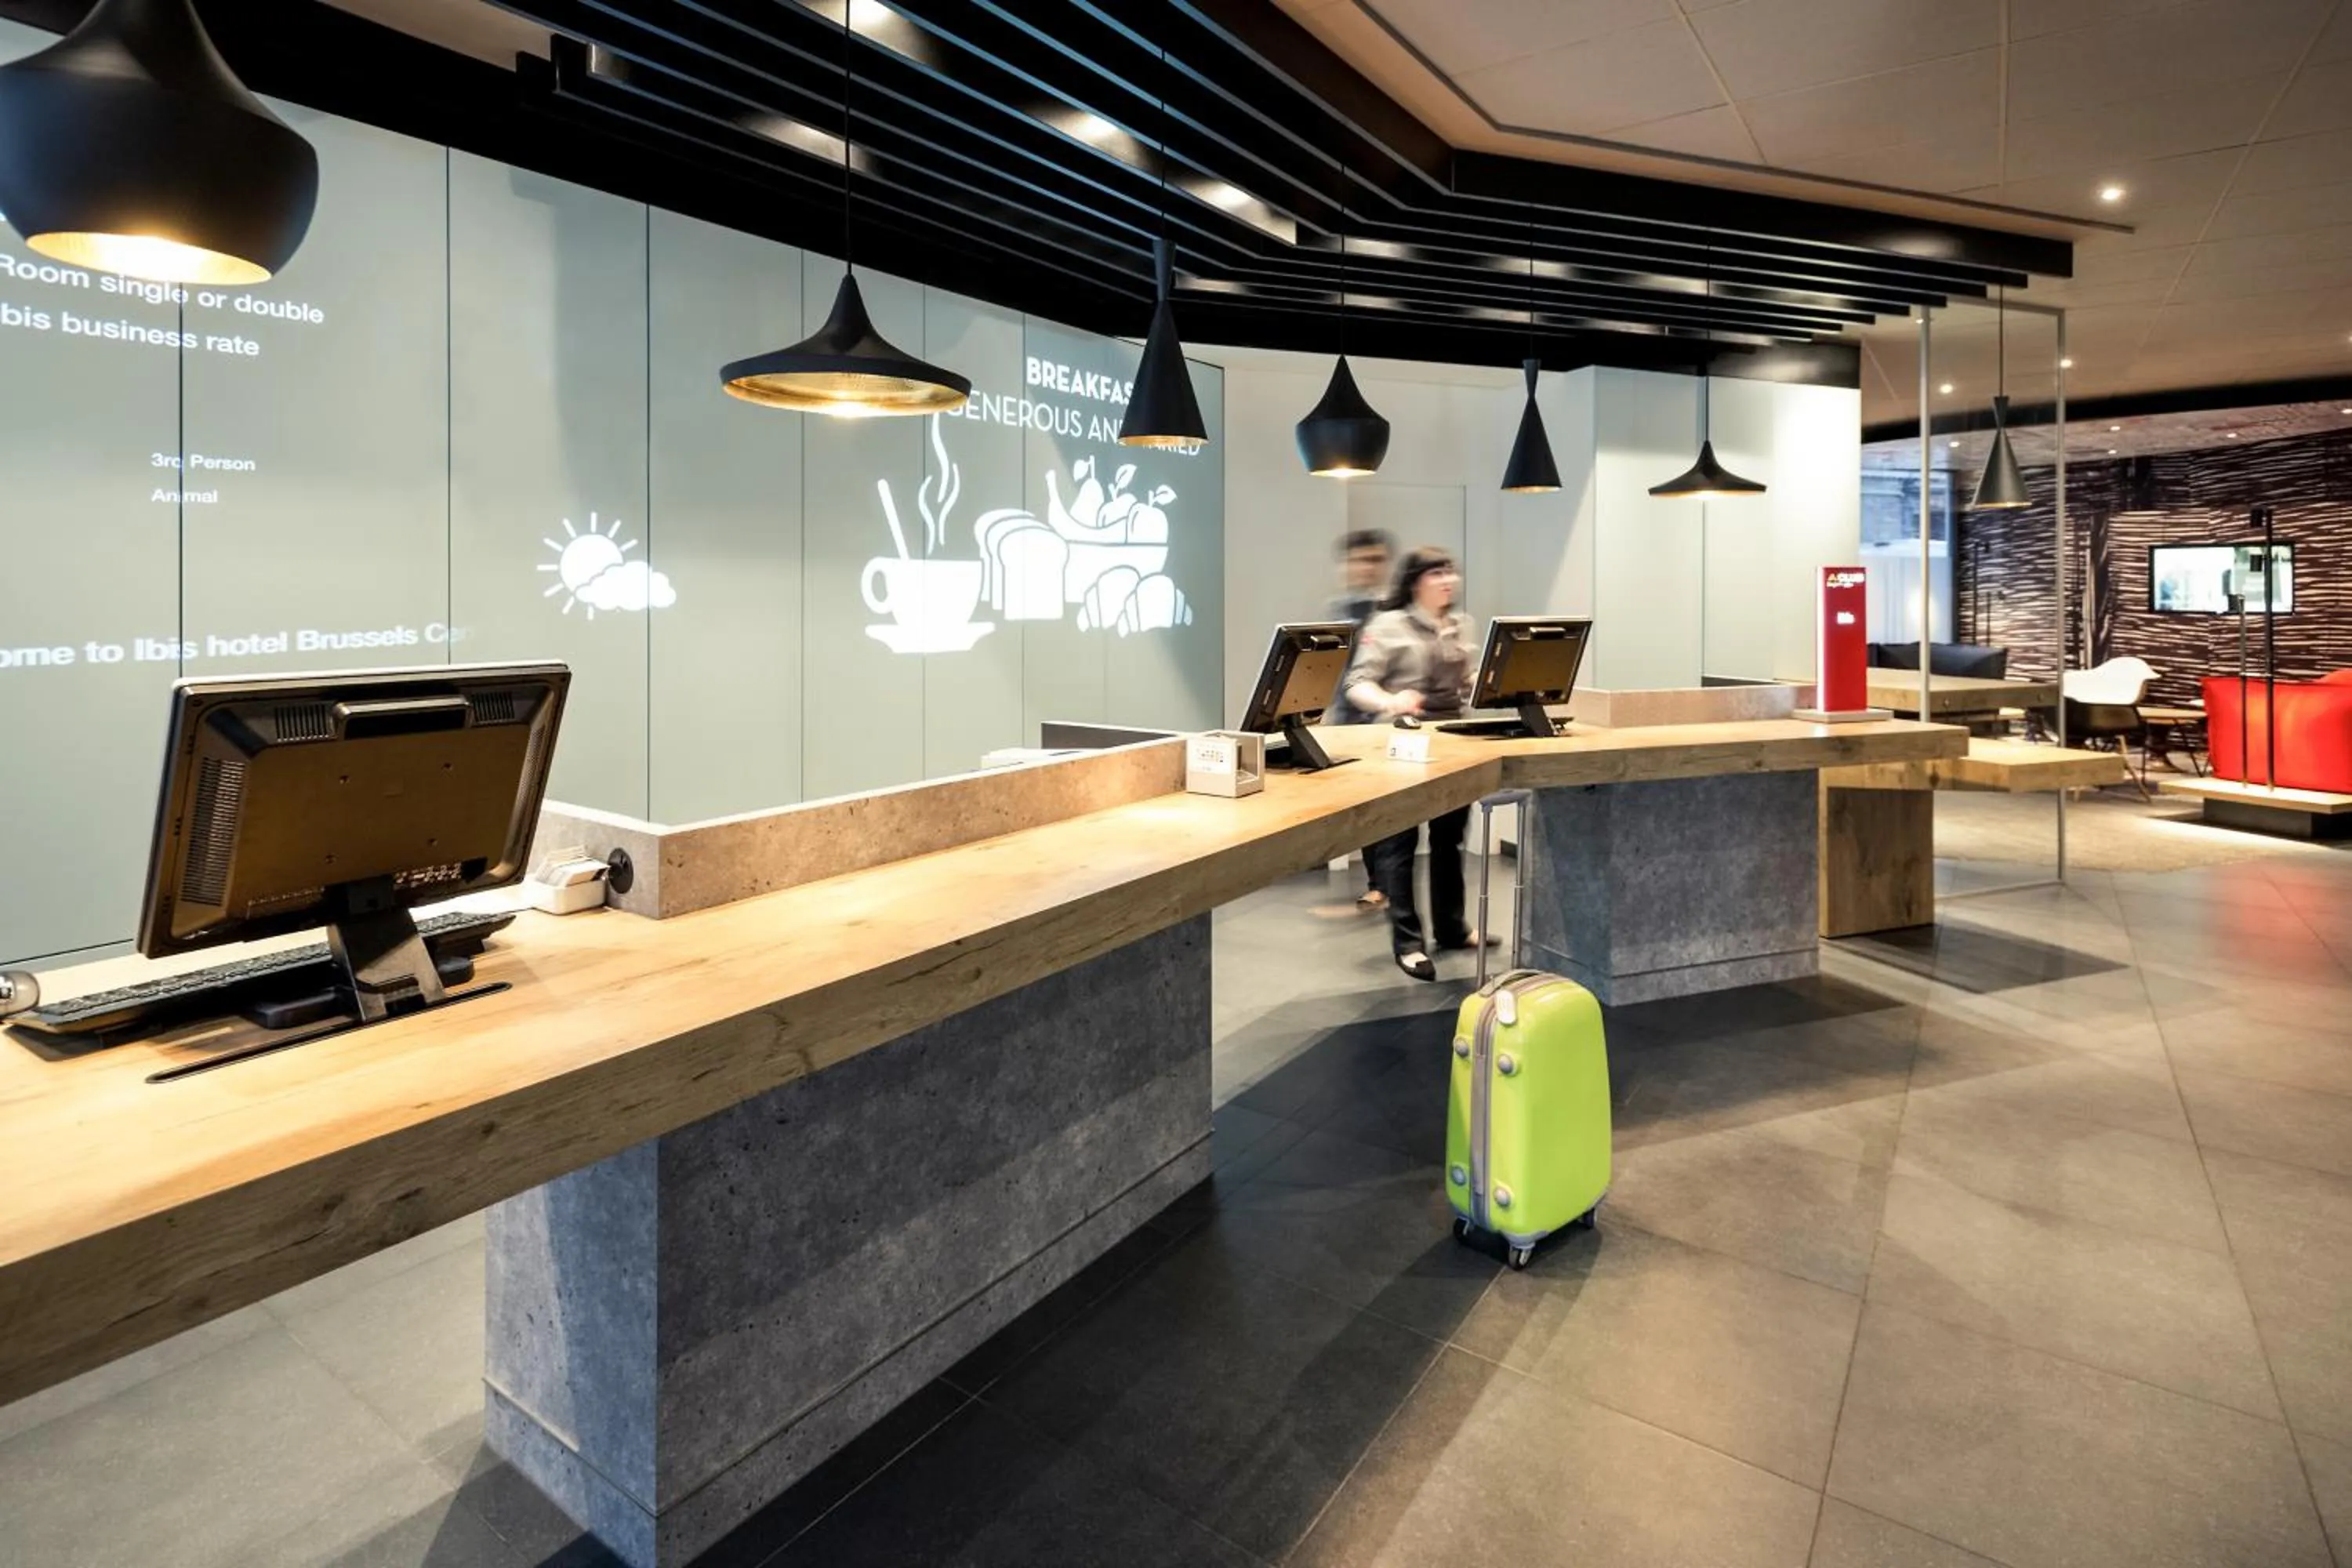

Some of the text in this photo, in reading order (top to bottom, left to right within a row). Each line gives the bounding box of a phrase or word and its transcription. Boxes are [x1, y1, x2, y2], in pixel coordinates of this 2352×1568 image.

[0, 254, 325, 324] Room single or double
[62, 311, 198, 348] business
[207, 336, 260, 356] rate
[1026, 356, 1134, 405] BREAKFAS
[151, 452, 256, 471] 3rd Person
[82, 641, 124, 662] to
[134, 637, 198, 661] Ibis
[207, 631, 288, 656] hotel
[296, 625, 419, 651] Brussels
